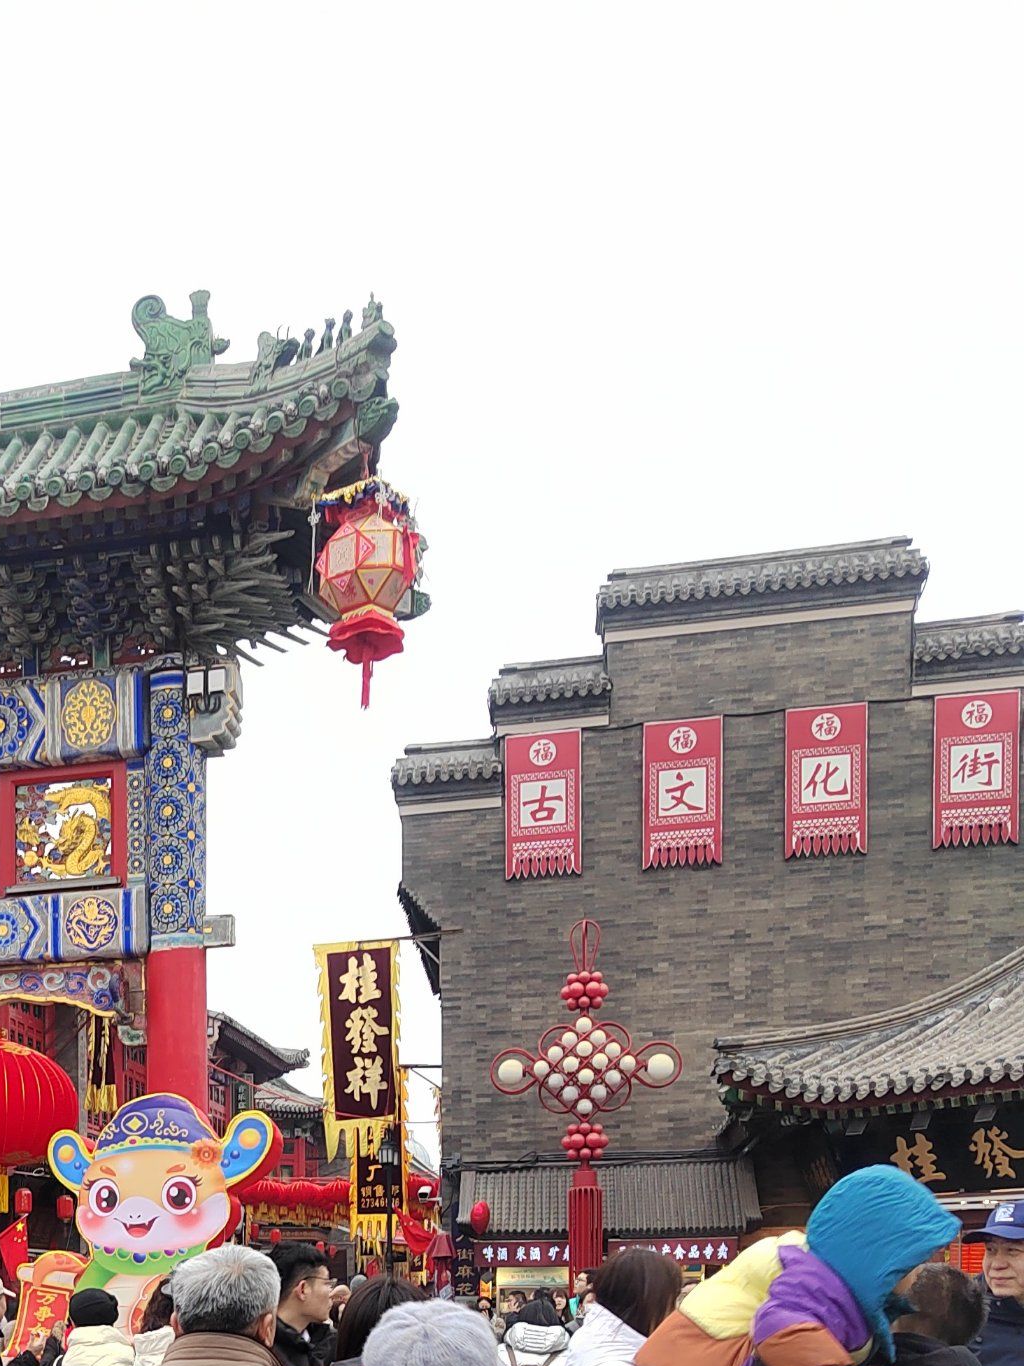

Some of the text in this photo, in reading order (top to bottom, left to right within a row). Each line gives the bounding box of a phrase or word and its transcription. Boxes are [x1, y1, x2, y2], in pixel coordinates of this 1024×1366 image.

[814, 714, 838, 739] 福
[964, 702, 989, 727] 福
[531, 741, 554, 763] 福
[672, 728, 694, 751] 福
[804, 761, 850, 798] 化
[953, 749, 999, 787] 街
[522, 785, 563, 821] 古
[663, 772, 704, 812] 文
